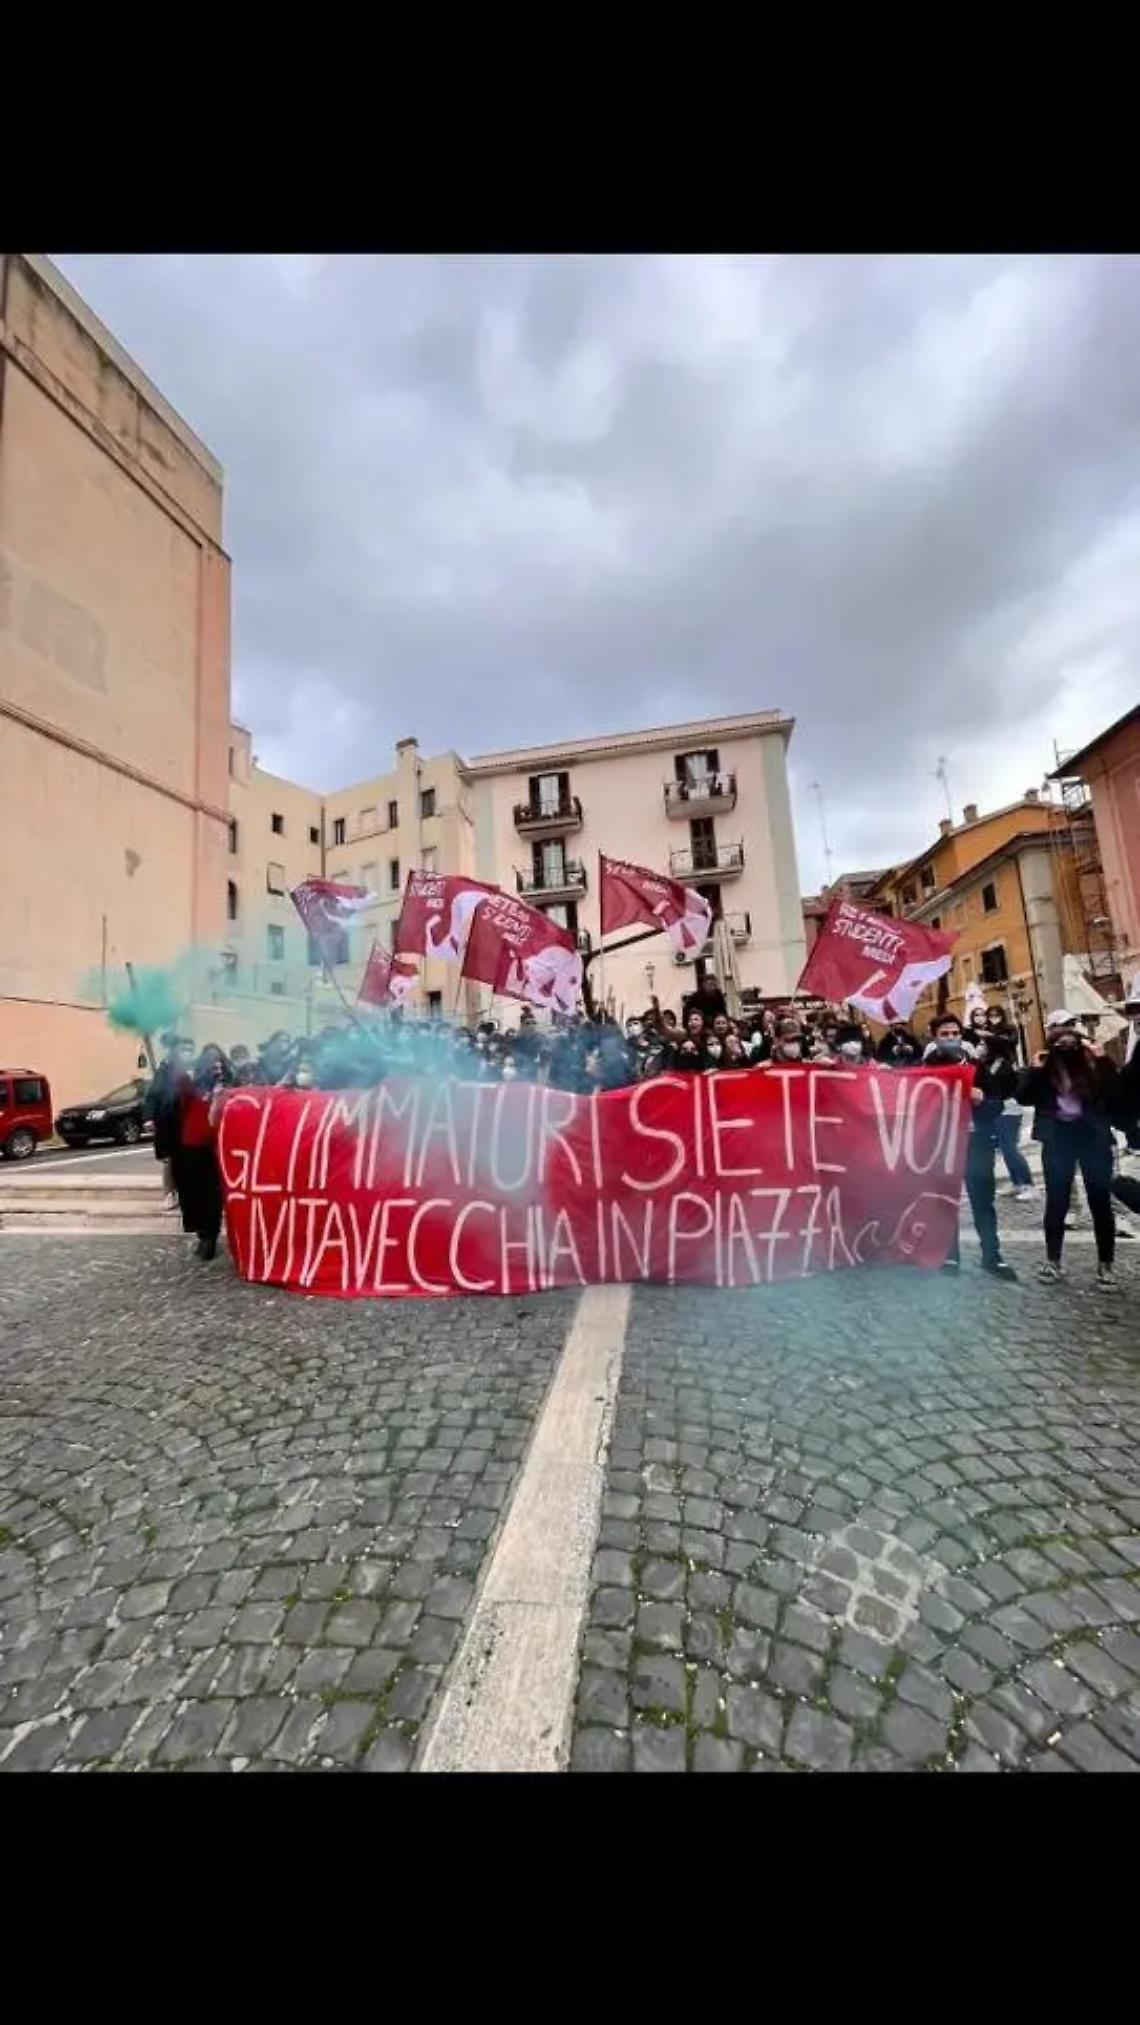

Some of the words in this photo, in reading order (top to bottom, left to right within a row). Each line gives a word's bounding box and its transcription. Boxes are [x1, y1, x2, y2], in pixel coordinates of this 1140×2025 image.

[218, 1094, 311, 1193] GLI
[308, 1080, 603, 1192] IMMATURI
[621, 1070, 857, 1191] SIETE
[869, 1075, 963, 1176] VOI
[597, 1198, 654, 1283] IN
[668, 1184, 856, 1288] PIAZZA
